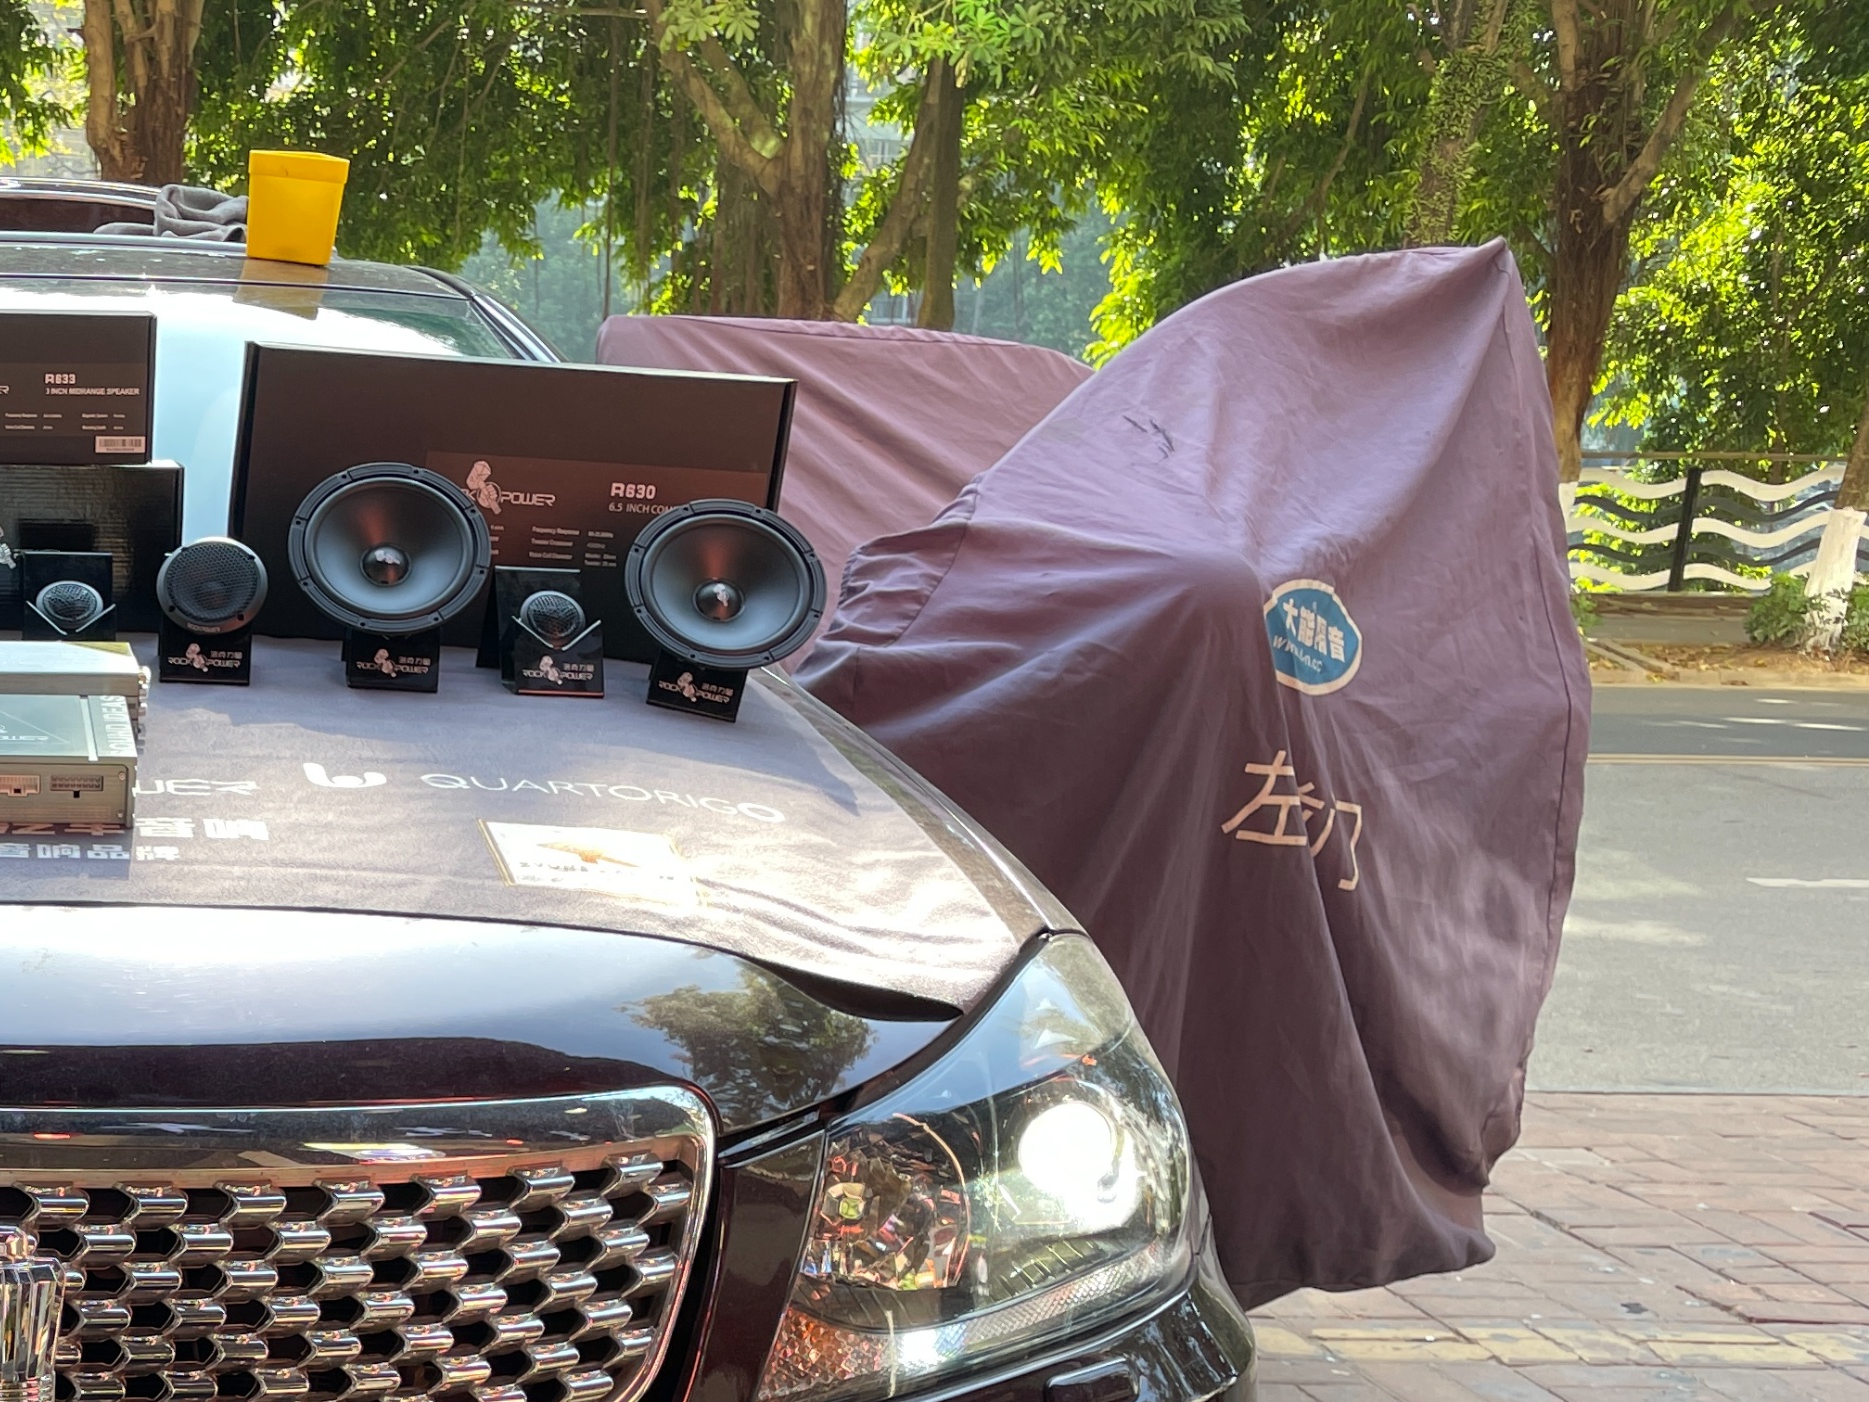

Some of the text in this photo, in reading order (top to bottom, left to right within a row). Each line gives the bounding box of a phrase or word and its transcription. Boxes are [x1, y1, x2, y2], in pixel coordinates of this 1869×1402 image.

[106, 387, 140, 396] SPEAKER
[610, 482, 656, 500] R630
[501, 491, 556, 507] POWER
[608, 502, 623, 513] 6.5
[626, 503, 651, 514] INCH
[205, 658, 241, 668] POWER
[394, 663, 429, 674] POWER
[559, 671, 593, 681] POWER
[695, 689, 731, 704] POWER
[420, 772, 786, 824] QUARTORIGO
